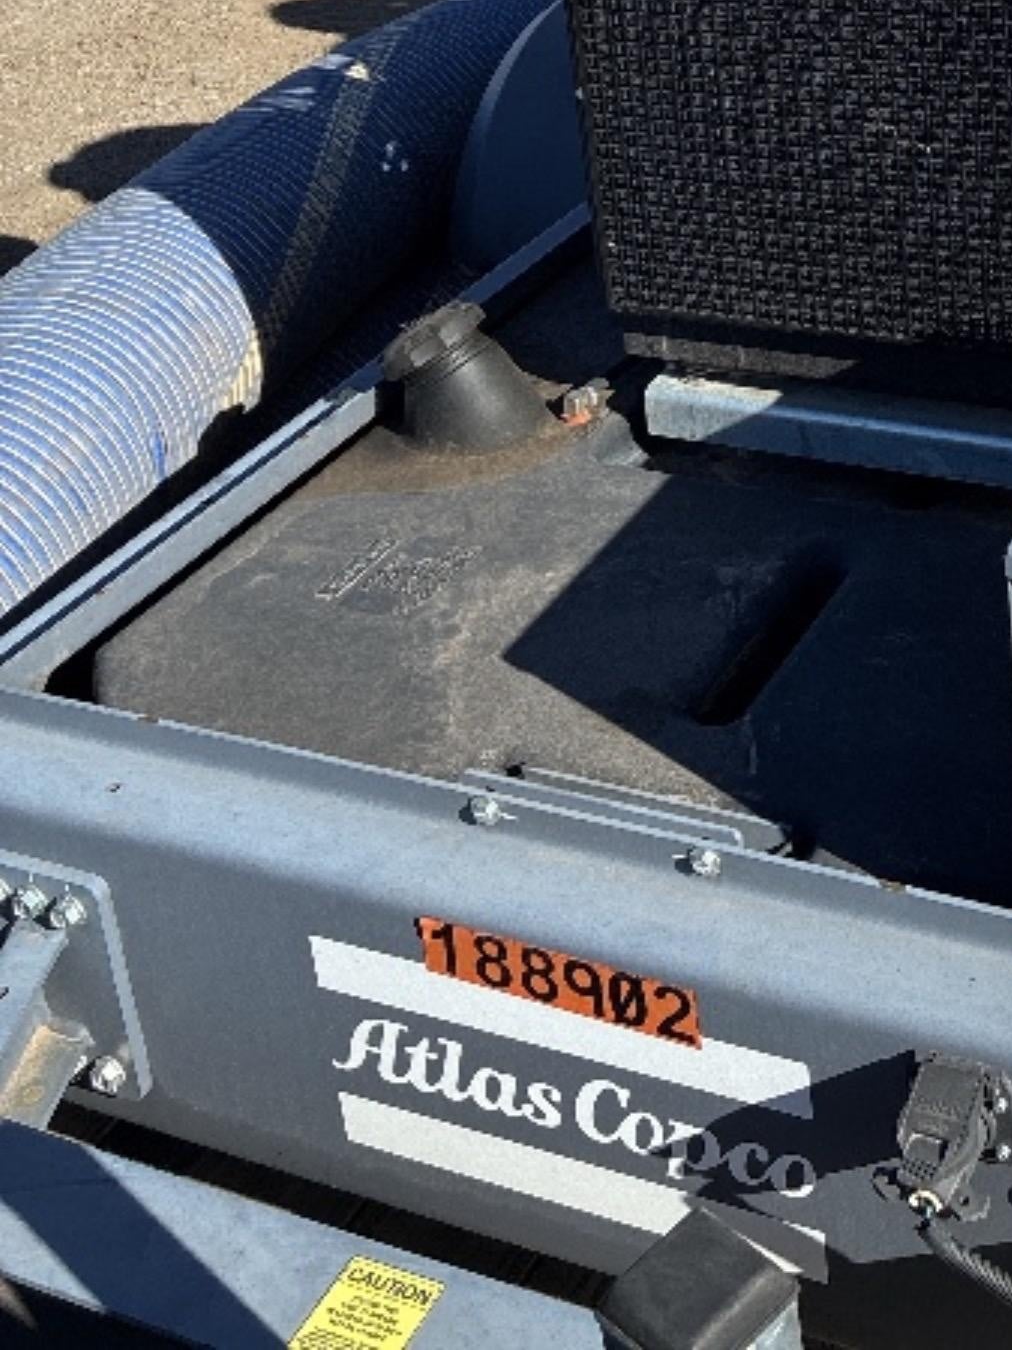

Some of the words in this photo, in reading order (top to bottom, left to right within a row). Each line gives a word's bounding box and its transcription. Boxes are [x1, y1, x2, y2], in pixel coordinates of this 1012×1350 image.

[430, 922, 697, 1044] 188902
[333, 1018, 562, 1128] Atlas
[575, 1079, 817, 1198] Copco
[347, 1267, 433, 1306] CAUTION
